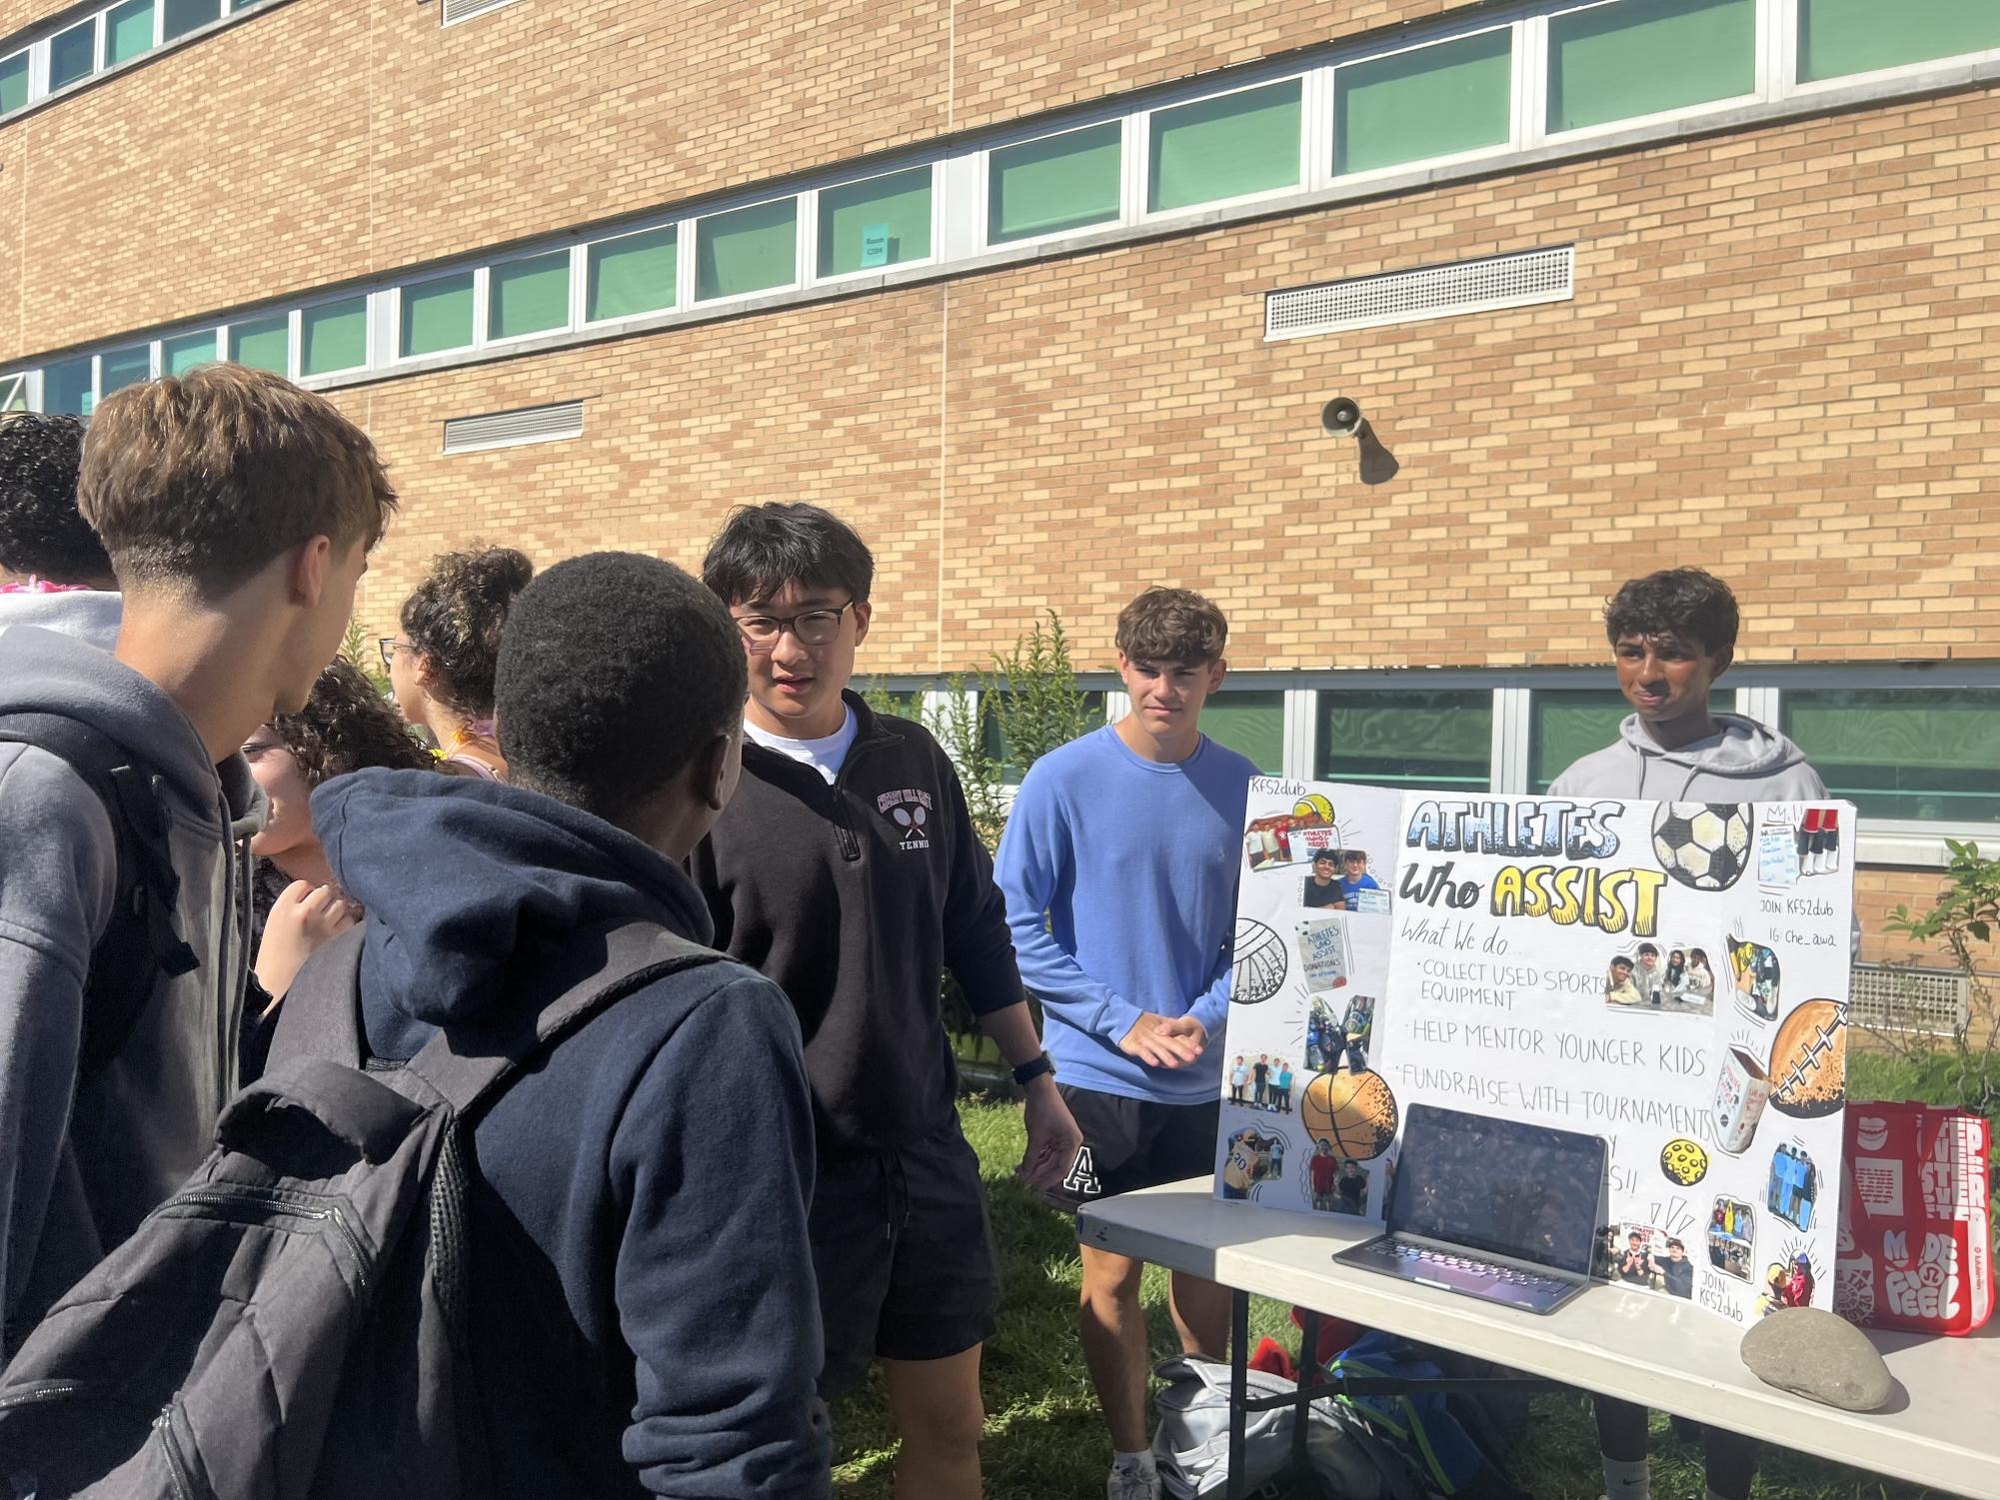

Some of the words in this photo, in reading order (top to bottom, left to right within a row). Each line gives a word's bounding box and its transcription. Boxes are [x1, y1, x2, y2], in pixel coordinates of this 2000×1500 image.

[1405, 800, 1625, 860] ATHLETES
[1489, 865, 1669, 938] ASSIST
[1760, 899, 1782, 915] JOIN
[1401, 916, 1447, 948] What
[1483, 925, 1508, 956] do
[1422, 958, 1487, 982] COLLECT
[1492, 965, 1538, 987] USED
[1421, 980, 1516, 1011] EQUIPMENT
[1412, 1019, 1458, 1043] HELP
[1465, 1024, 1545, 1054] MENTOR
[1554, 1032, 1646, 1067] YOUNGER
[1658, 1043, 1706, 1077] KIDS
[1402, 1063, 1509, 1106] FUNDRAISE
[1518, 1082, 1569, 1114] WITH
[1582, 1090, 1712, 1142] TOURNAMENTS
[1063, 1145, 1102, 1194] A
[1702, 1269, 1726, 1295] JOIN
